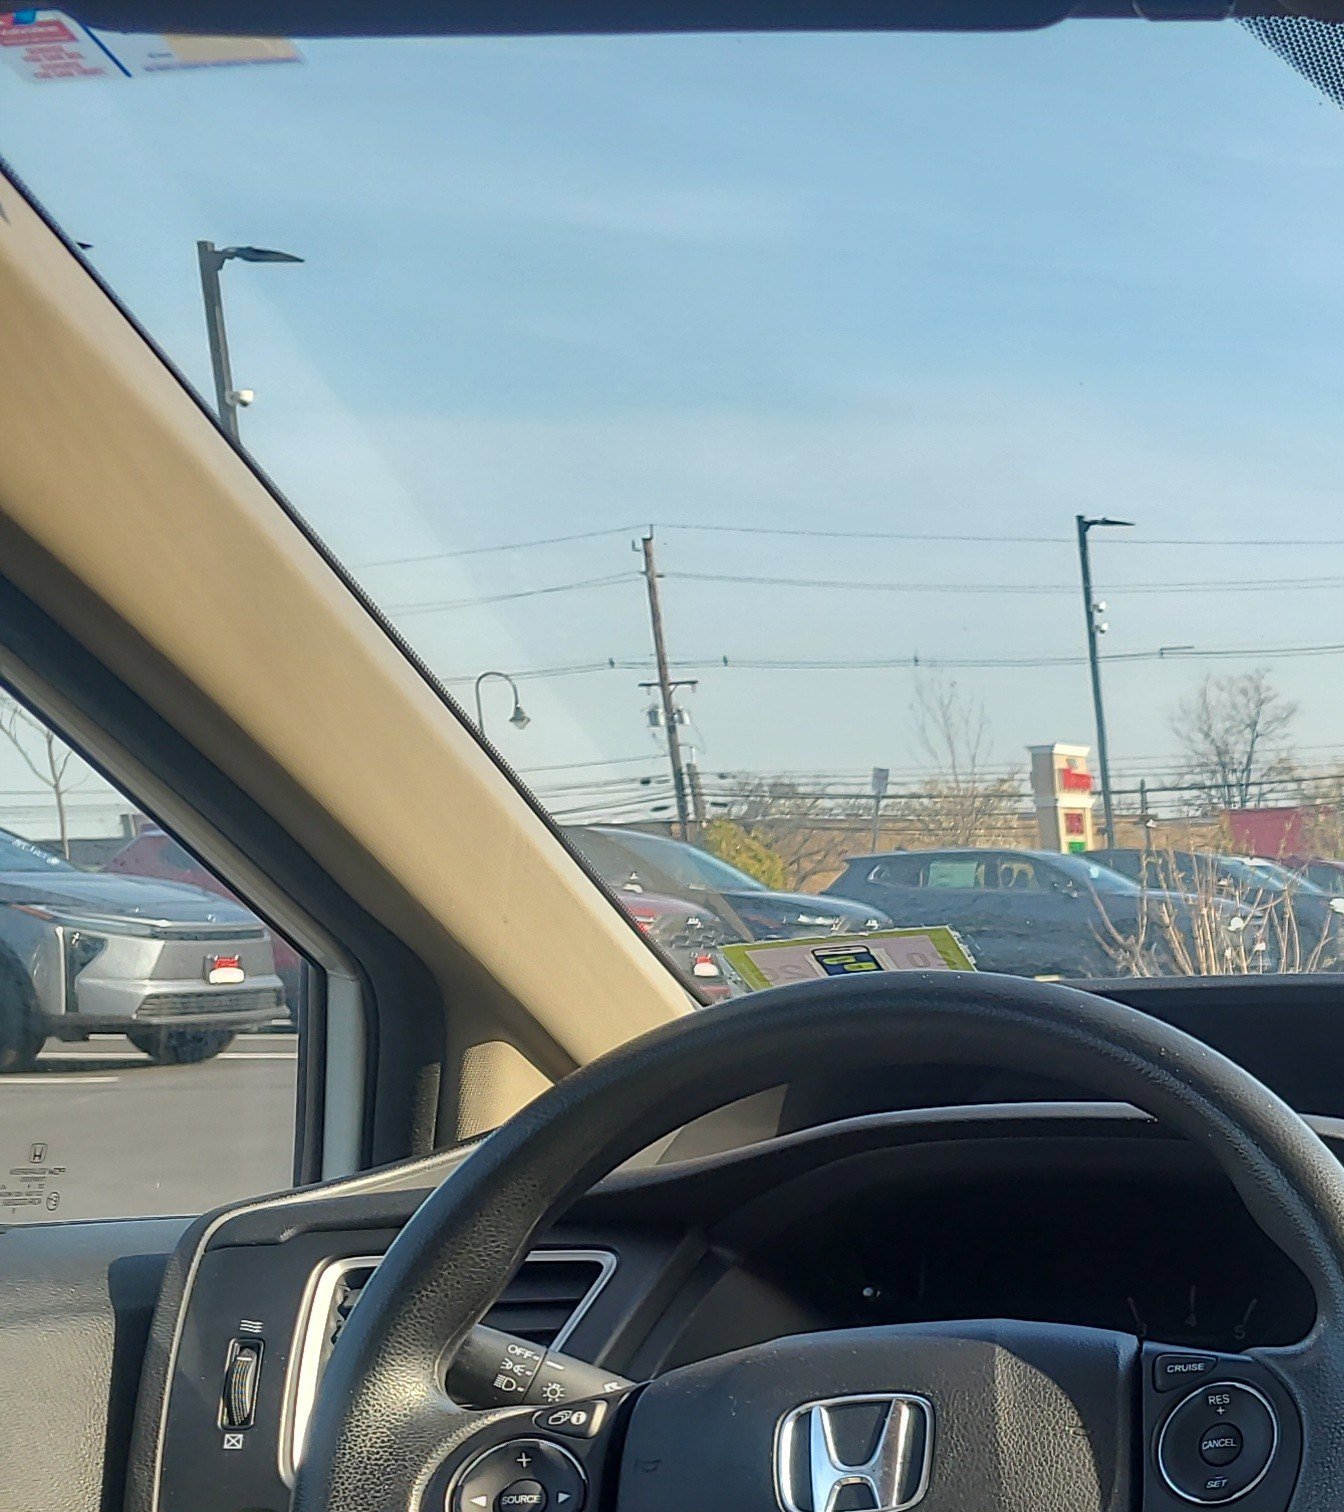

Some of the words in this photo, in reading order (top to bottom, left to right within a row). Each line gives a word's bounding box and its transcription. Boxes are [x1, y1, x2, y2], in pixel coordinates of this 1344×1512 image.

[507, 1344, 536, 1359] OFF
[1166, 1362, 1205, 1374] CRUISE
[1208, 1393, 1230, 1406] RES
[1202, 1438, 1237, 1450] CANCEL
[1206, 1479, 1228, 1489] SET
[501, 1494, 541, 1505] SOURCE
